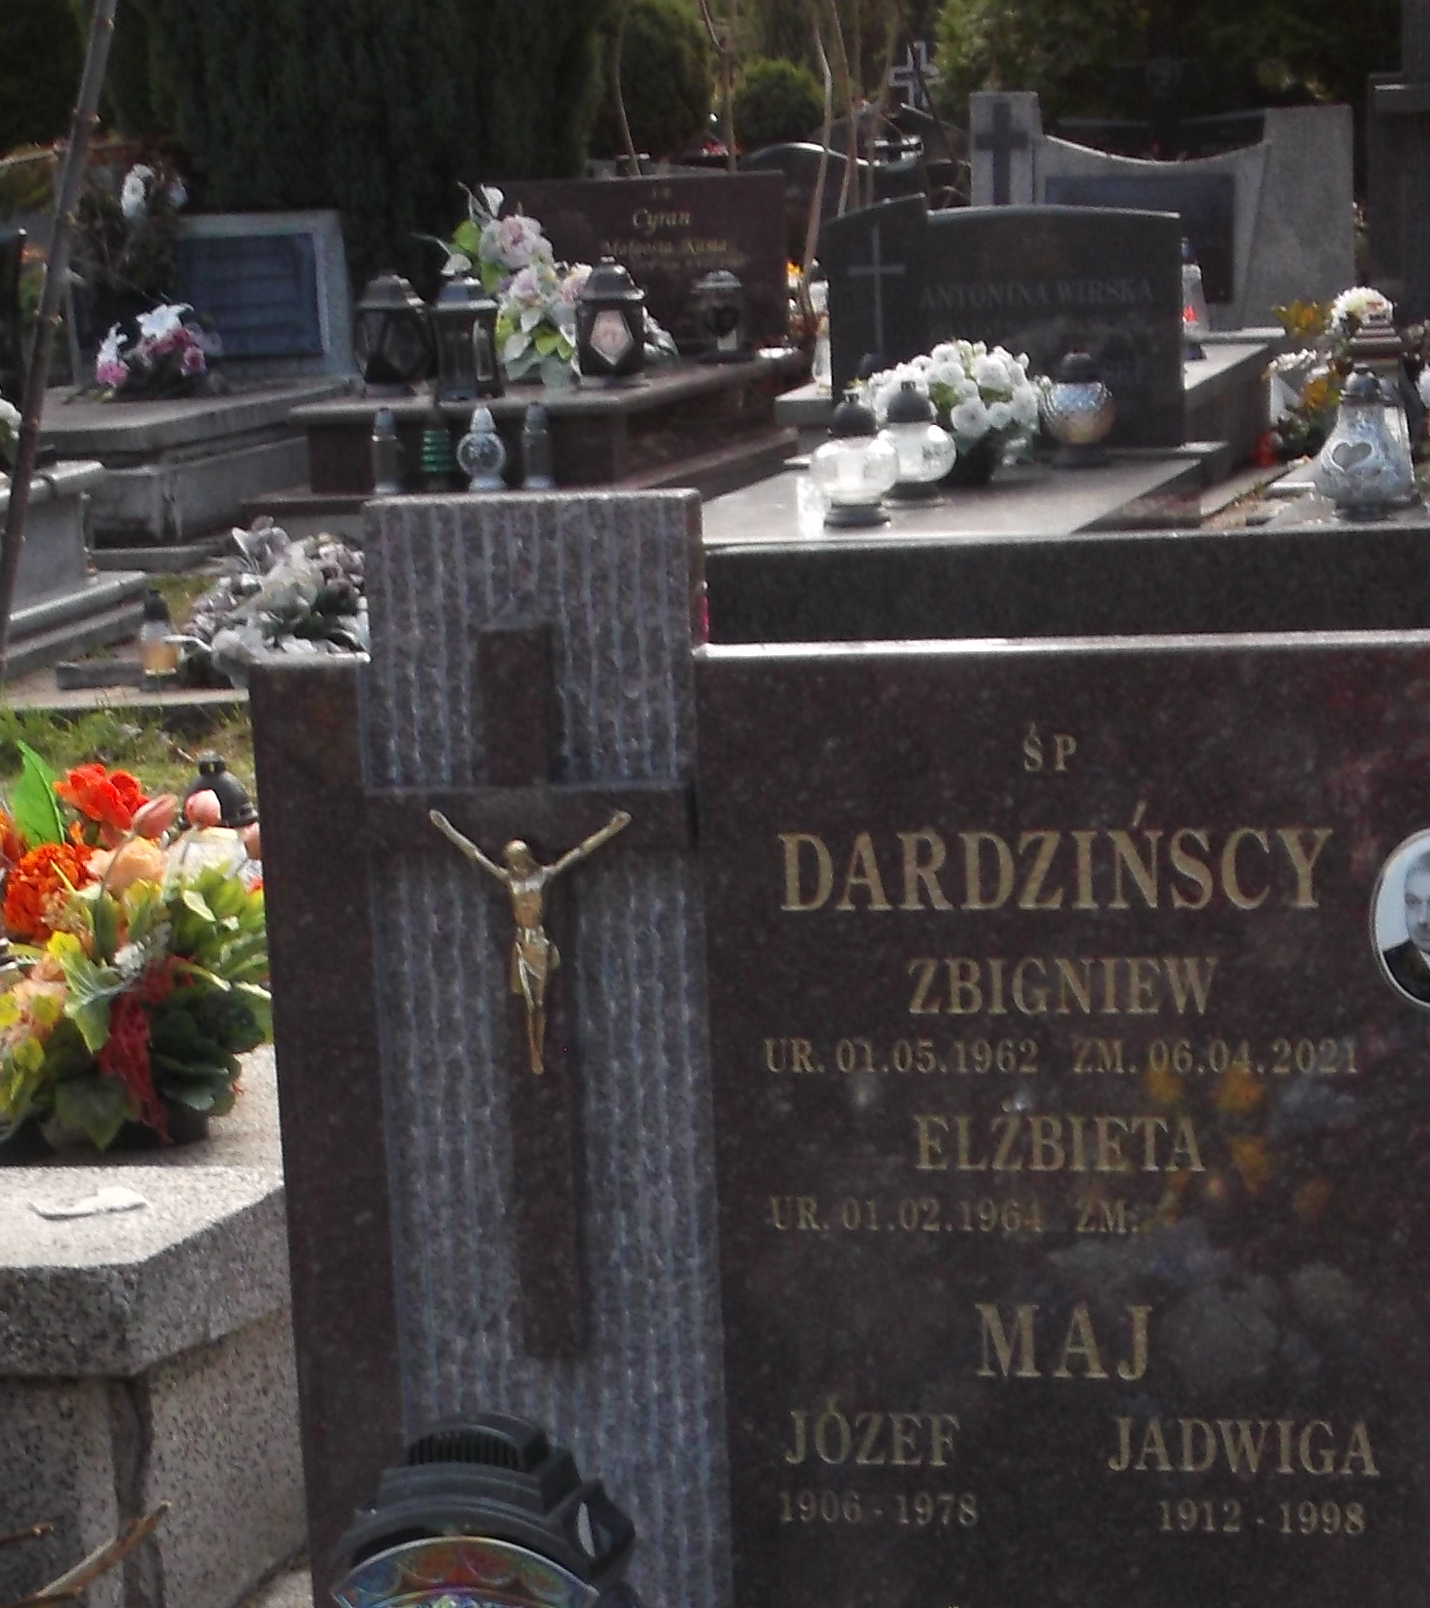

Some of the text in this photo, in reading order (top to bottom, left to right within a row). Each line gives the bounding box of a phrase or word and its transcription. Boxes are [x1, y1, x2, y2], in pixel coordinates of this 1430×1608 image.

[777, 801, 1334, 913] DARDZIŃSCY
[907, 955, 1221, 1015] ZBIGNIEW
[765, 1038, 1359, 1075] UR. 01.05.1962 ZM. 06.04.2021
[771, 1197, 827, 1233] UR.
[1075, 1197, 1140, 1234] ZM.
[975, 1302, 1154, 1381] MAJ
[784, 1398, 961, 1467] JÓZEF
[1107, 1415, 1381, 1477] JADWIGA
[779, 1490, 862, 1524] 1906
[896, 1492, 979, 1527] 1978
[1158, 1498, 1242, 1535] 1912
[1277, 1499, 1367, 1536] 1998
